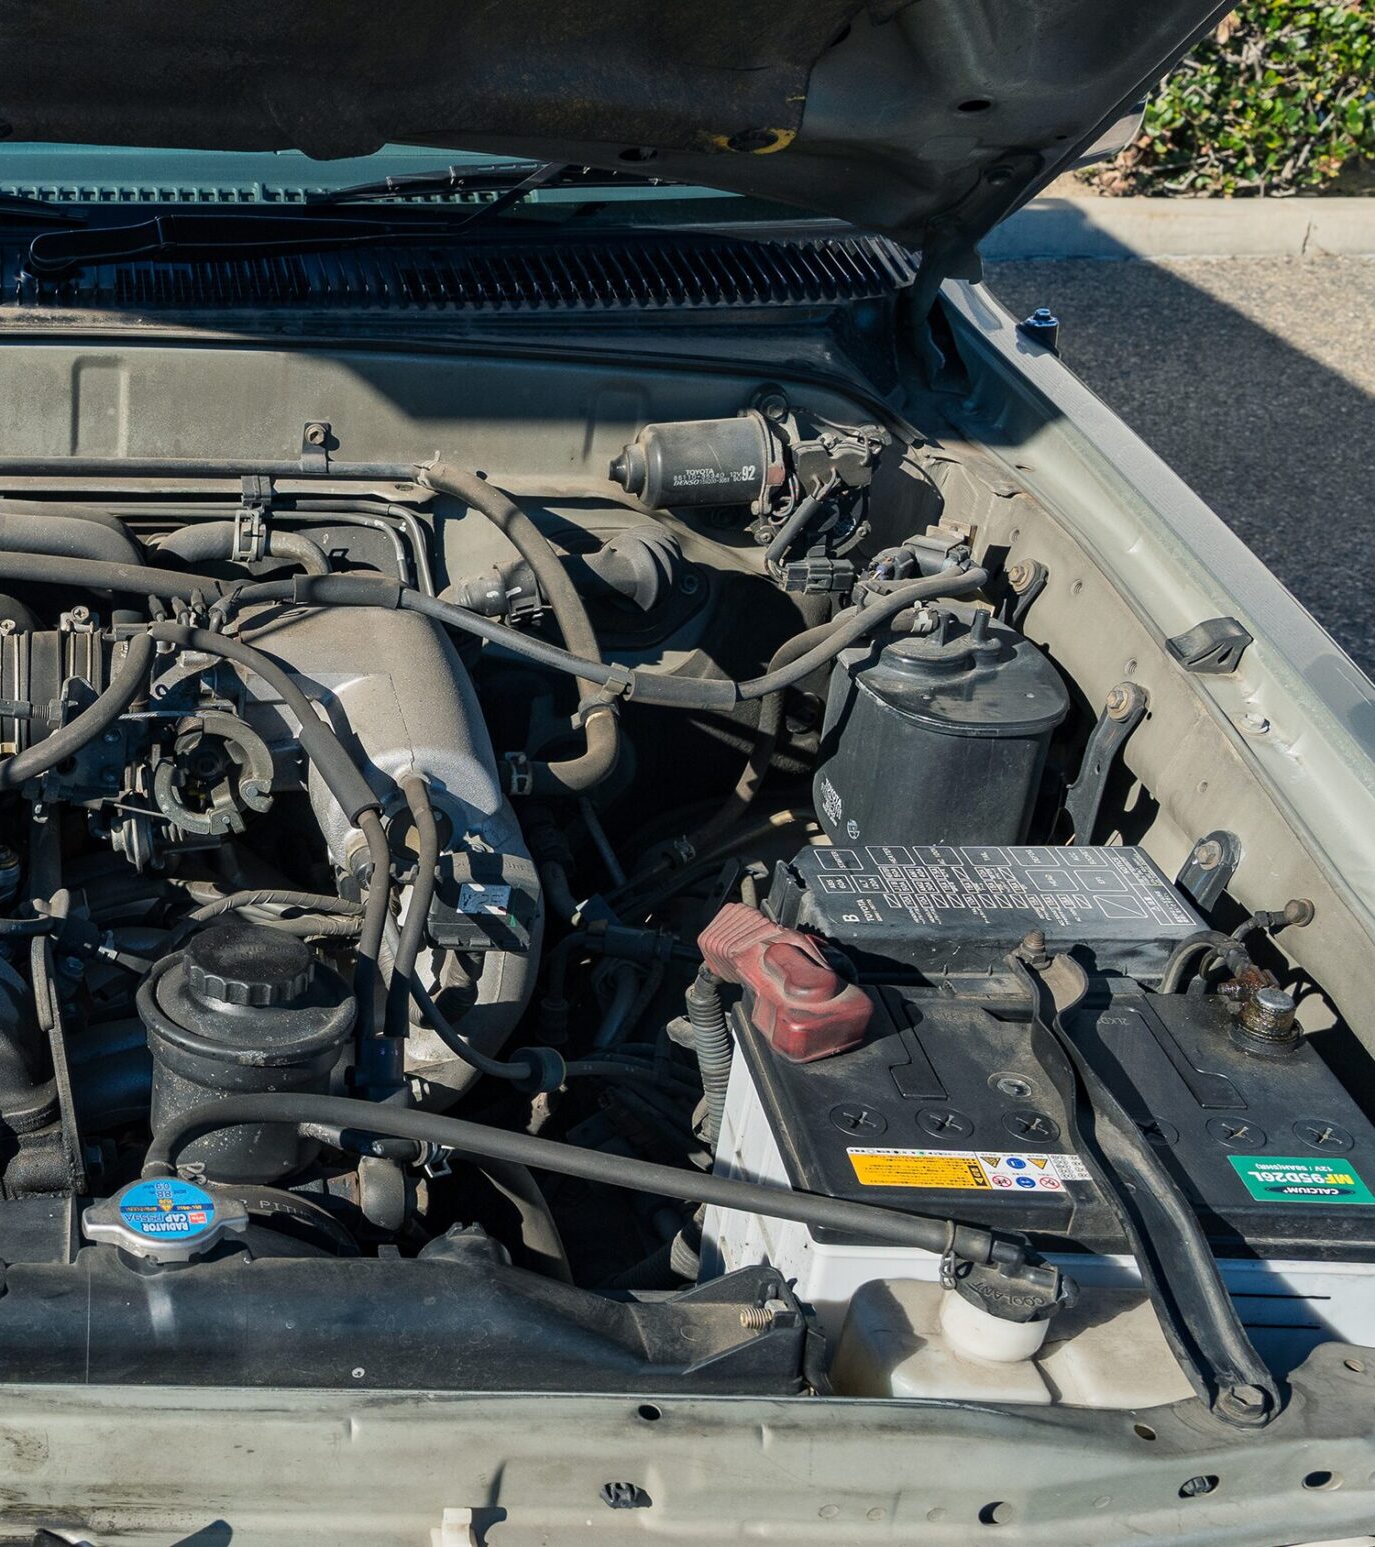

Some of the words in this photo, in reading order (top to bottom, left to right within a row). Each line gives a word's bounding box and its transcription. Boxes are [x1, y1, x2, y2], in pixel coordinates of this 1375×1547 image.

[742, 465, 756, 481] 92
[673, 479, 700, 487] DENSO
[856, 898, 874, 921] TOYOTA
[841, 913, 859, 922] B
[1248, 1170, 1355, 1185] MF95D26L
[165, 1213, 187, 1222] CAP
[142, 1222, 189, 1231] RADIATOR
[971, 1280, 1045, 1307] COOLANT
